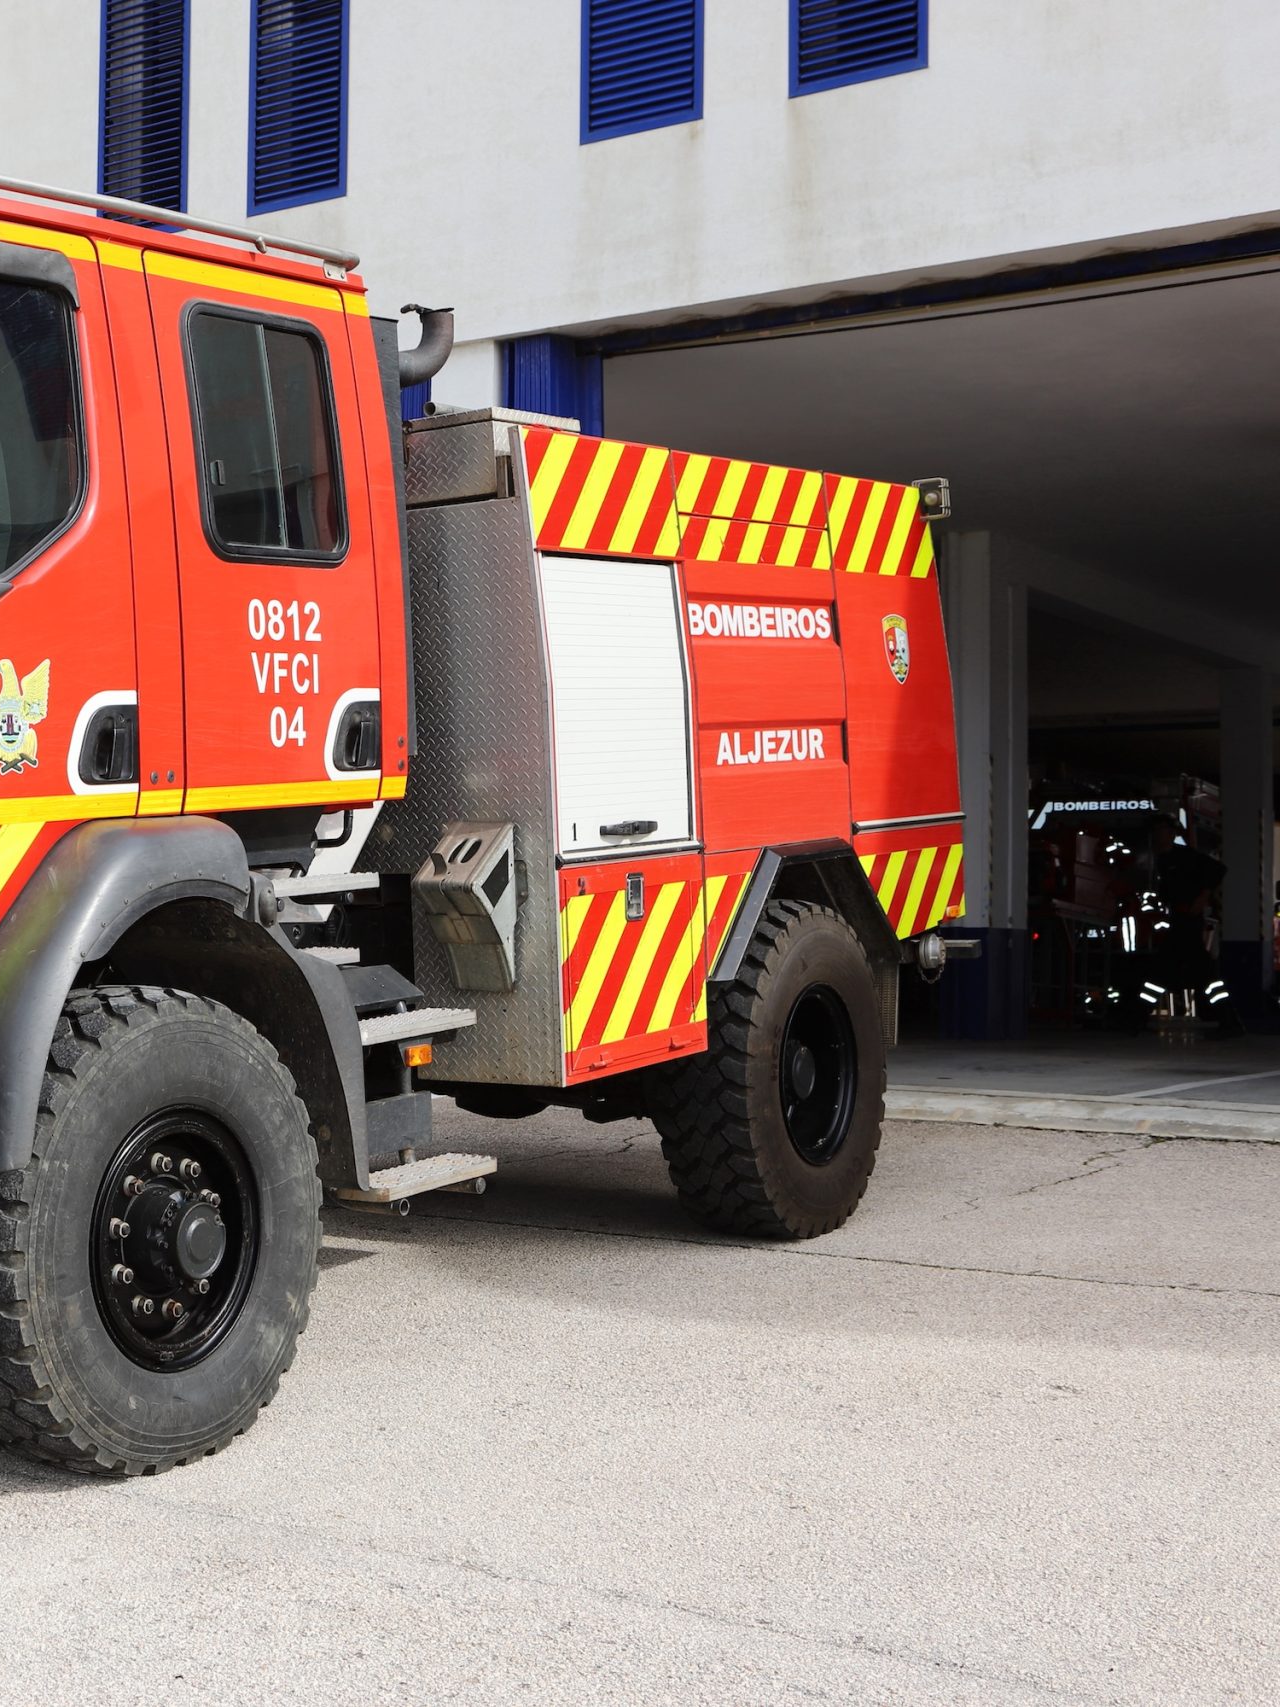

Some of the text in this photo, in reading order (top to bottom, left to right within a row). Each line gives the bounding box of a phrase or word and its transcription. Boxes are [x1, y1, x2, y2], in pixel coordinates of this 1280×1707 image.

[248, 598, 321, 642] 0812
[688, 603, 831, 639] BOMBEIROS
[251, 652, 319, 694] VFCI
[270, 707, 306, 748] 04
[717, 728, 825, 766] ALJEZUR
[1054, 800, 1150, 811] BOMBEIROS
[572, 822, 577, 841] 1
